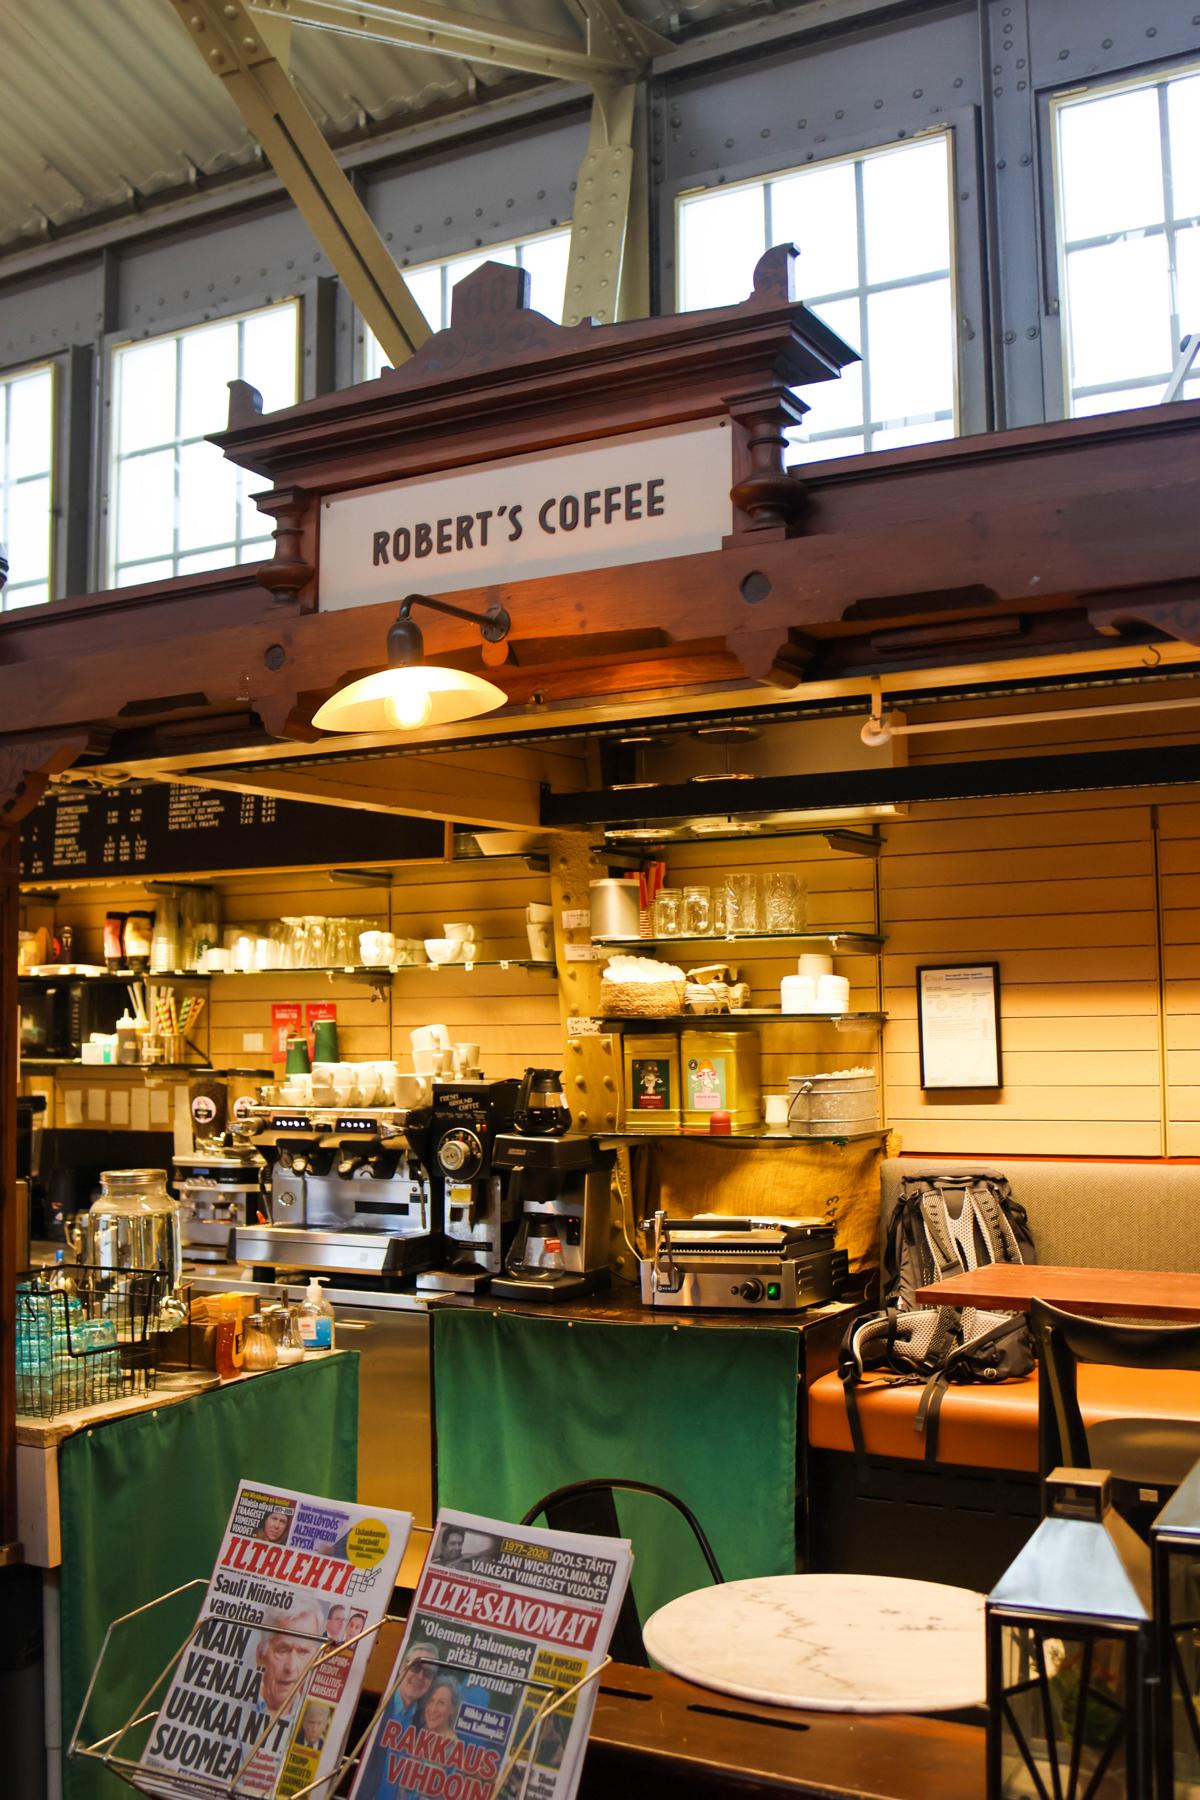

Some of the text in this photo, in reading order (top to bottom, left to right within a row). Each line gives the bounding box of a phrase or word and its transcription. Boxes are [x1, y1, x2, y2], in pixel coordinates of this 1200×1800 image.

[373, 478, 665, 566] ROBERT'S COFFEE
[294, 1524, 337, 1542] ALZHEIMERIN
[297, 1512, 313, 1524] UUSI
[221, 1536, 356, 1595] ILTALEHTI
[497, 1552, 521, 1568] JANI
[552, 1550, 616, 1574] IDOLS-TÄHTI
[214, 1574, 248, 1598] Sauli
[246, 1582, 295, 1610] Niinistö
[471, 1560, 608, 1601] VAIKEAT VIIMEISET VUODET
[209, 1598, 265, 1624] varoittaa
[446, 1646, 527, 1678] pitää matalaa
[472, 1632, 533, 1663] halunneet
[181, 1651, 267, 1705] VENÄJÄ
[165, 1687, 243, 1740] UHKAA
[149, 1724, 242, 1780] SUOMEA
[381, 1720, 500, 1779] RAKKAUS
[387, 1755, 496, 1800] VIHDOIN
